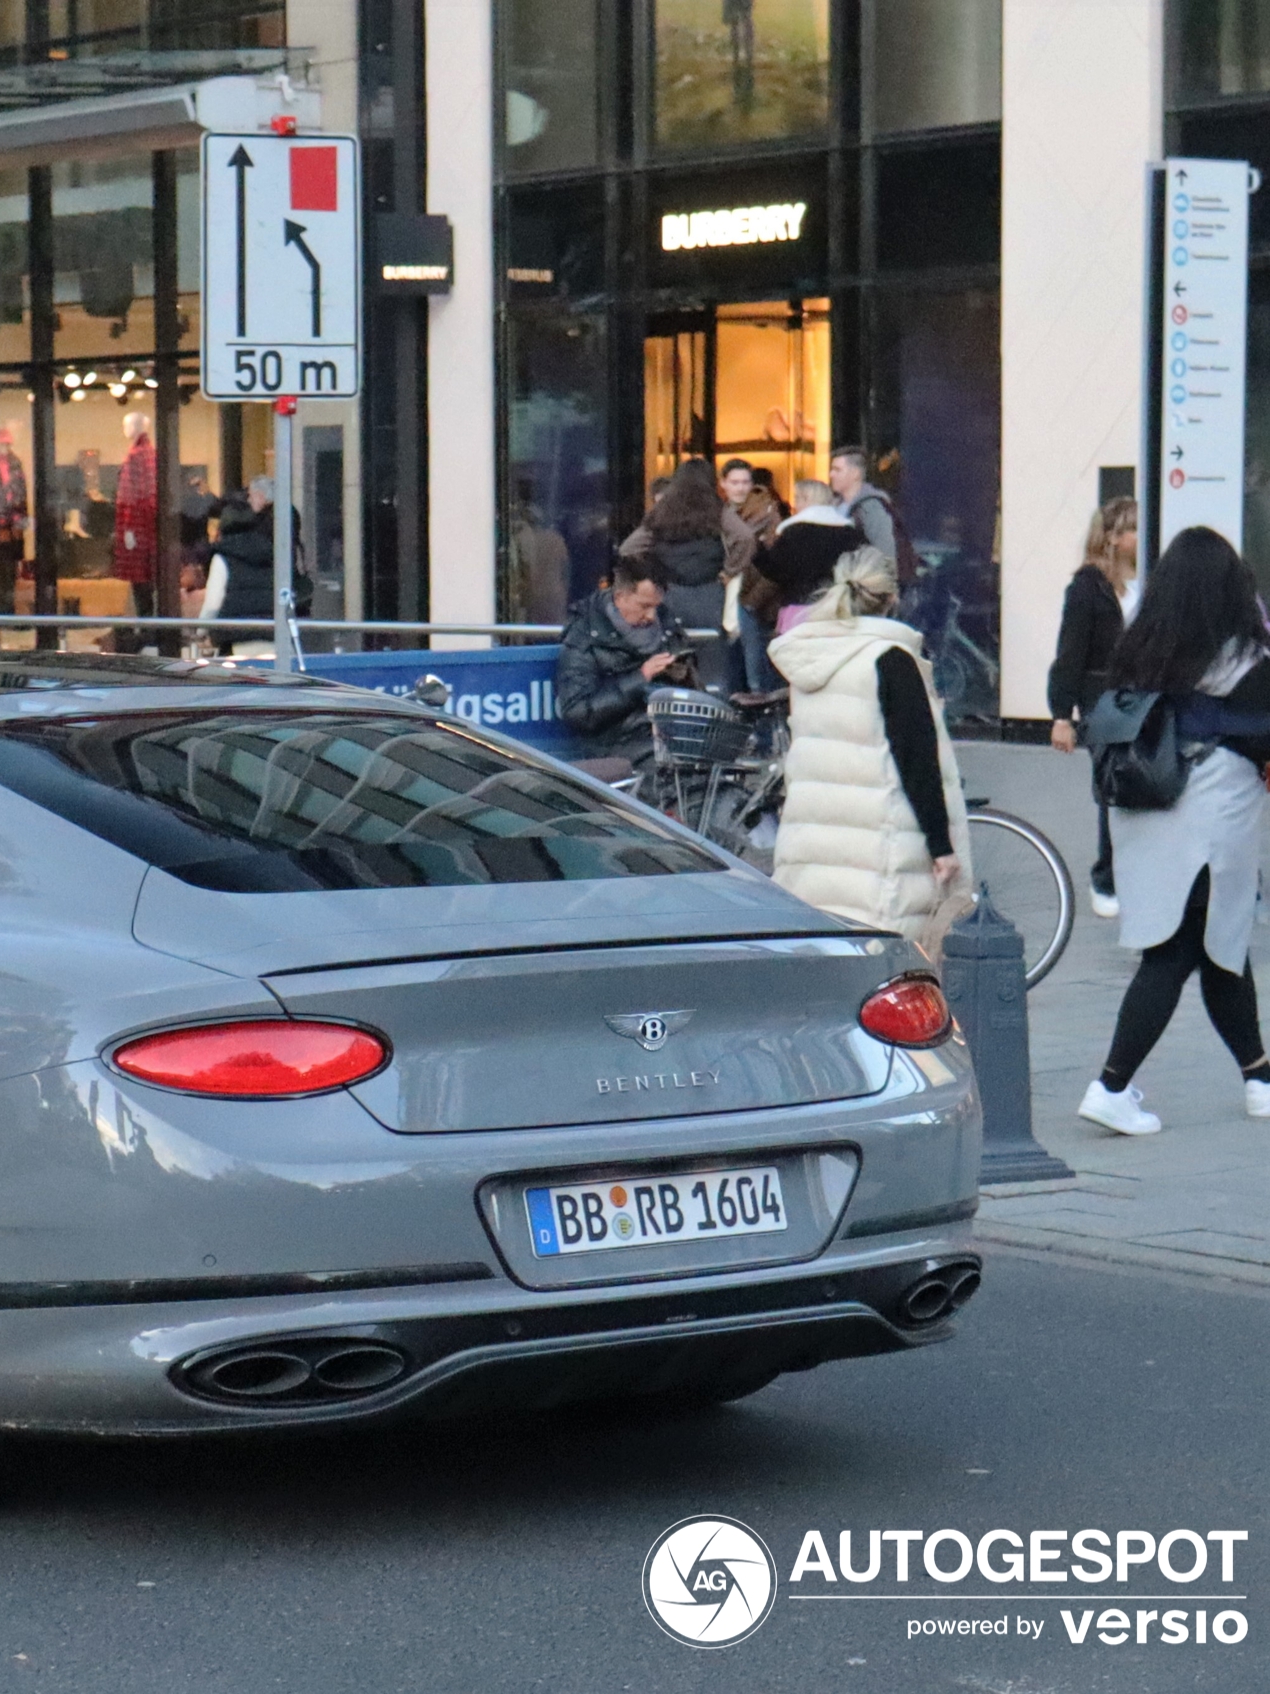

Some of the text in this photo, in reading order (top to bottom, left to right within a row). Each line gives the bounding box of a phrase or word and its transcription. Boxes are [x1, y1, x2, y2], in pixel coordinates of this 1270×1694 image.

[661, 202, 807, 250] BURBERRY
[234, 349, 337, 392] 50 m
[596, 1069, 721, 1094] BENTLEY
[556, 1174, 780, 1245] BB RB 1604
[540, 1229, 551, 1244] D
